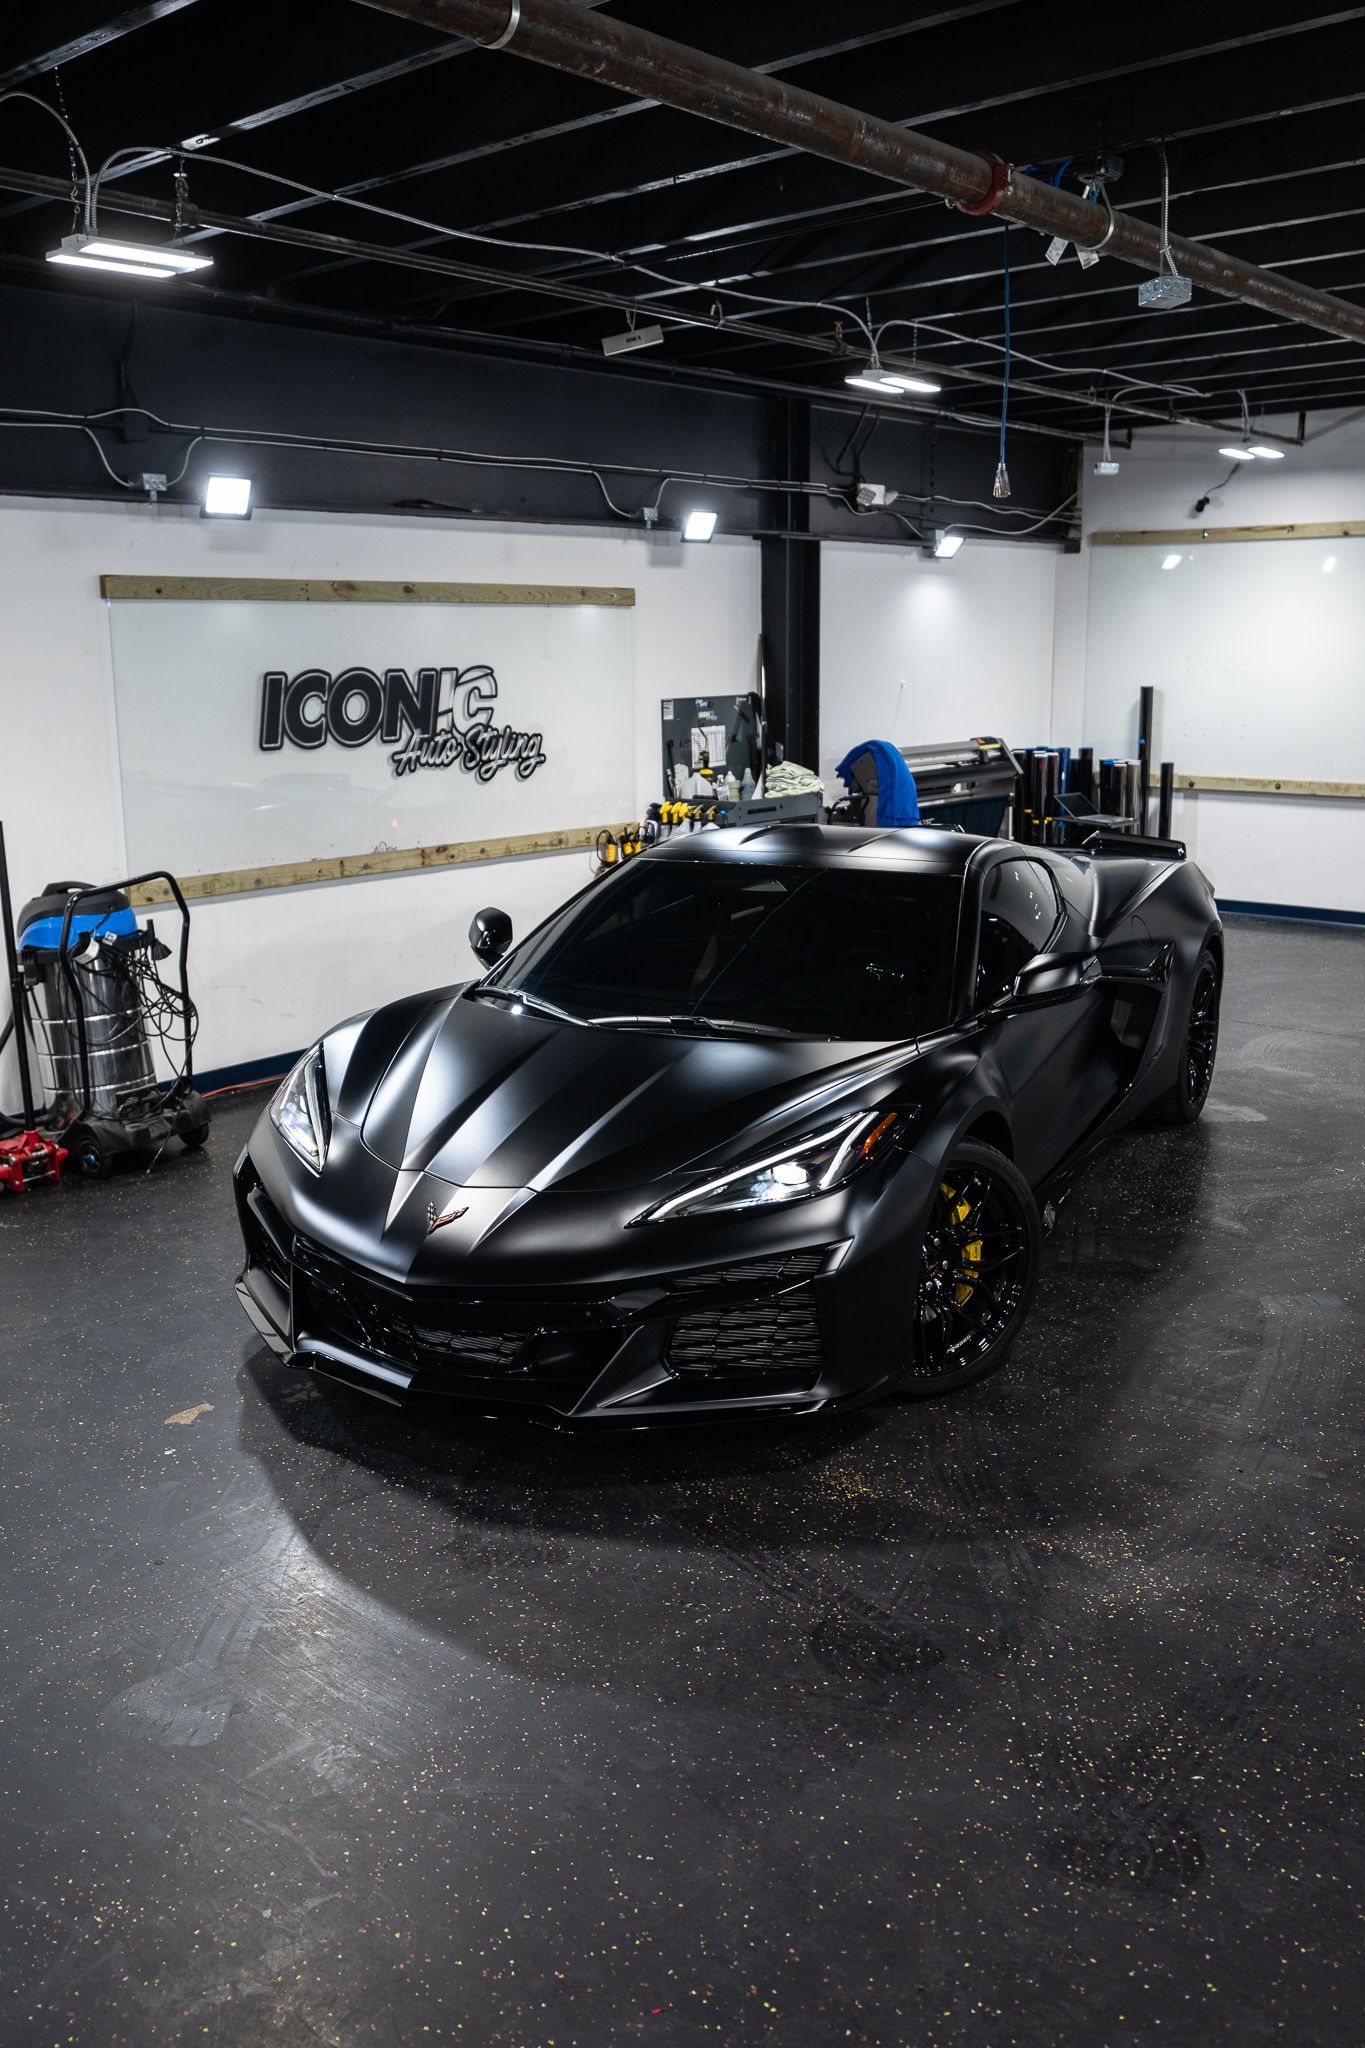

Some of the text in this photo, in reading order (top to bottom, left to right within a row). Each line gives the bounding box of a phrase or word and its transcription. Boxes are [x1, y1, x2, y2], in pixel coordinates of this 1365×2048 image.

[259, 665, 498, 750] ICONIC
[391, 722, 546, 782] Auto Styling
